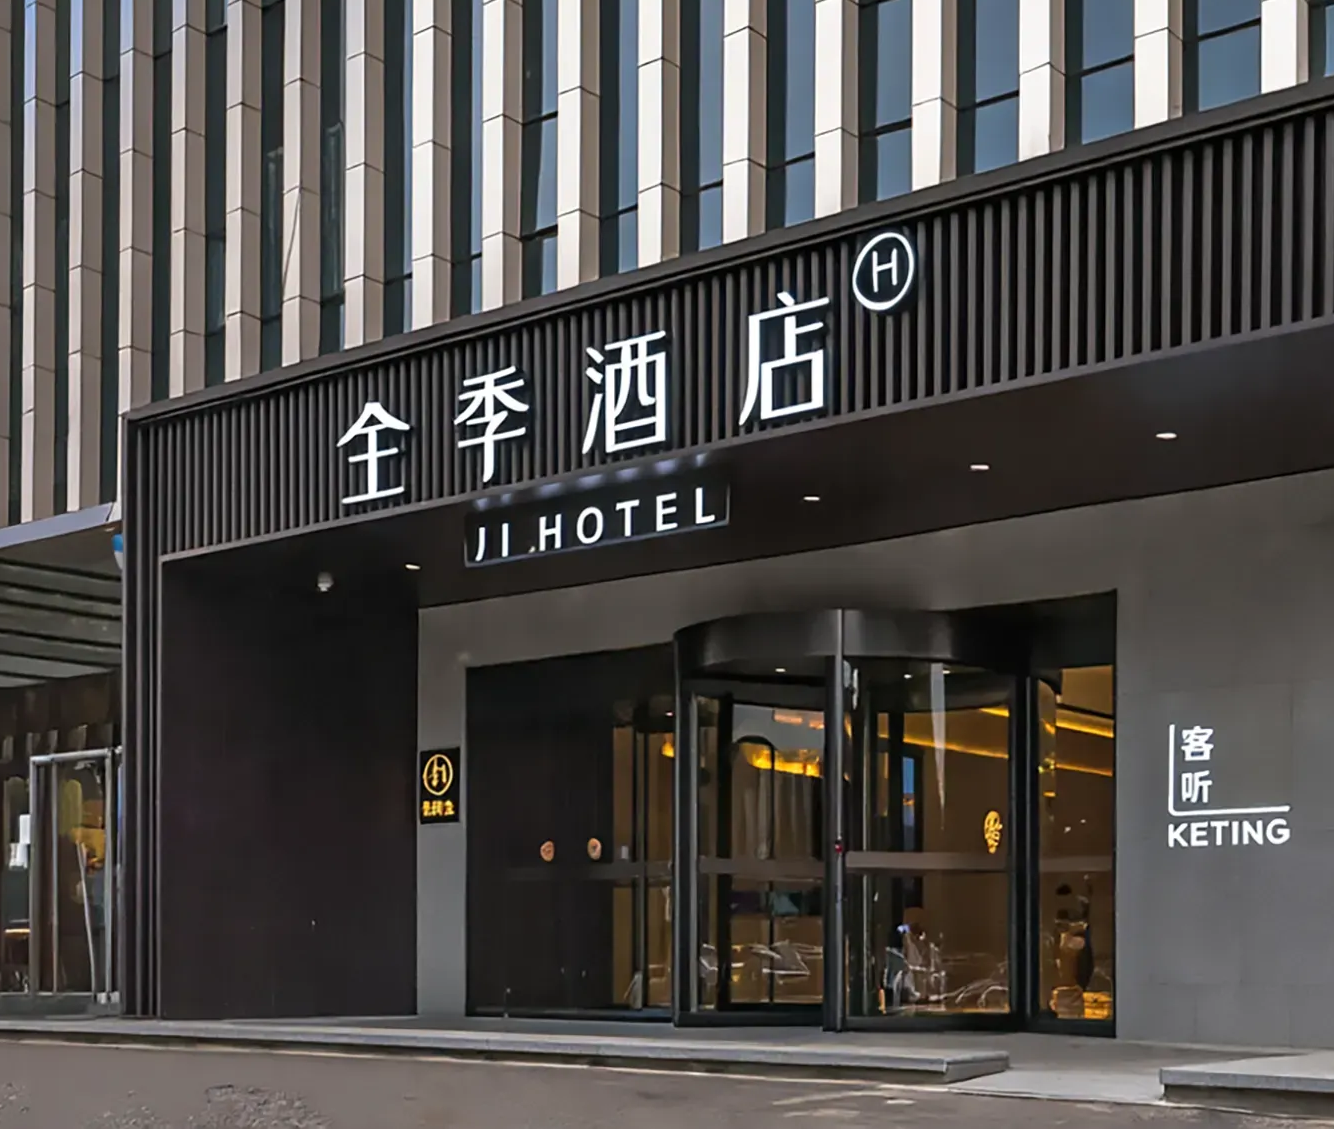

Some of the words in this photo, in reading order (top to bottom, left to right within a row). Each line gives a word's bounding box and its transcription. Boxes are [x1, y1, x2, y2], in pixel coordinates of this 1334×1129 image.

[336, 291, 830, 505] 全季酒店
[474, 522, 510, 562] JI
[538, 486, 716, 552] HOTEL
[1180, 725, 1214, 803] 客听
[1168, 818, 1291, 848] KETING
